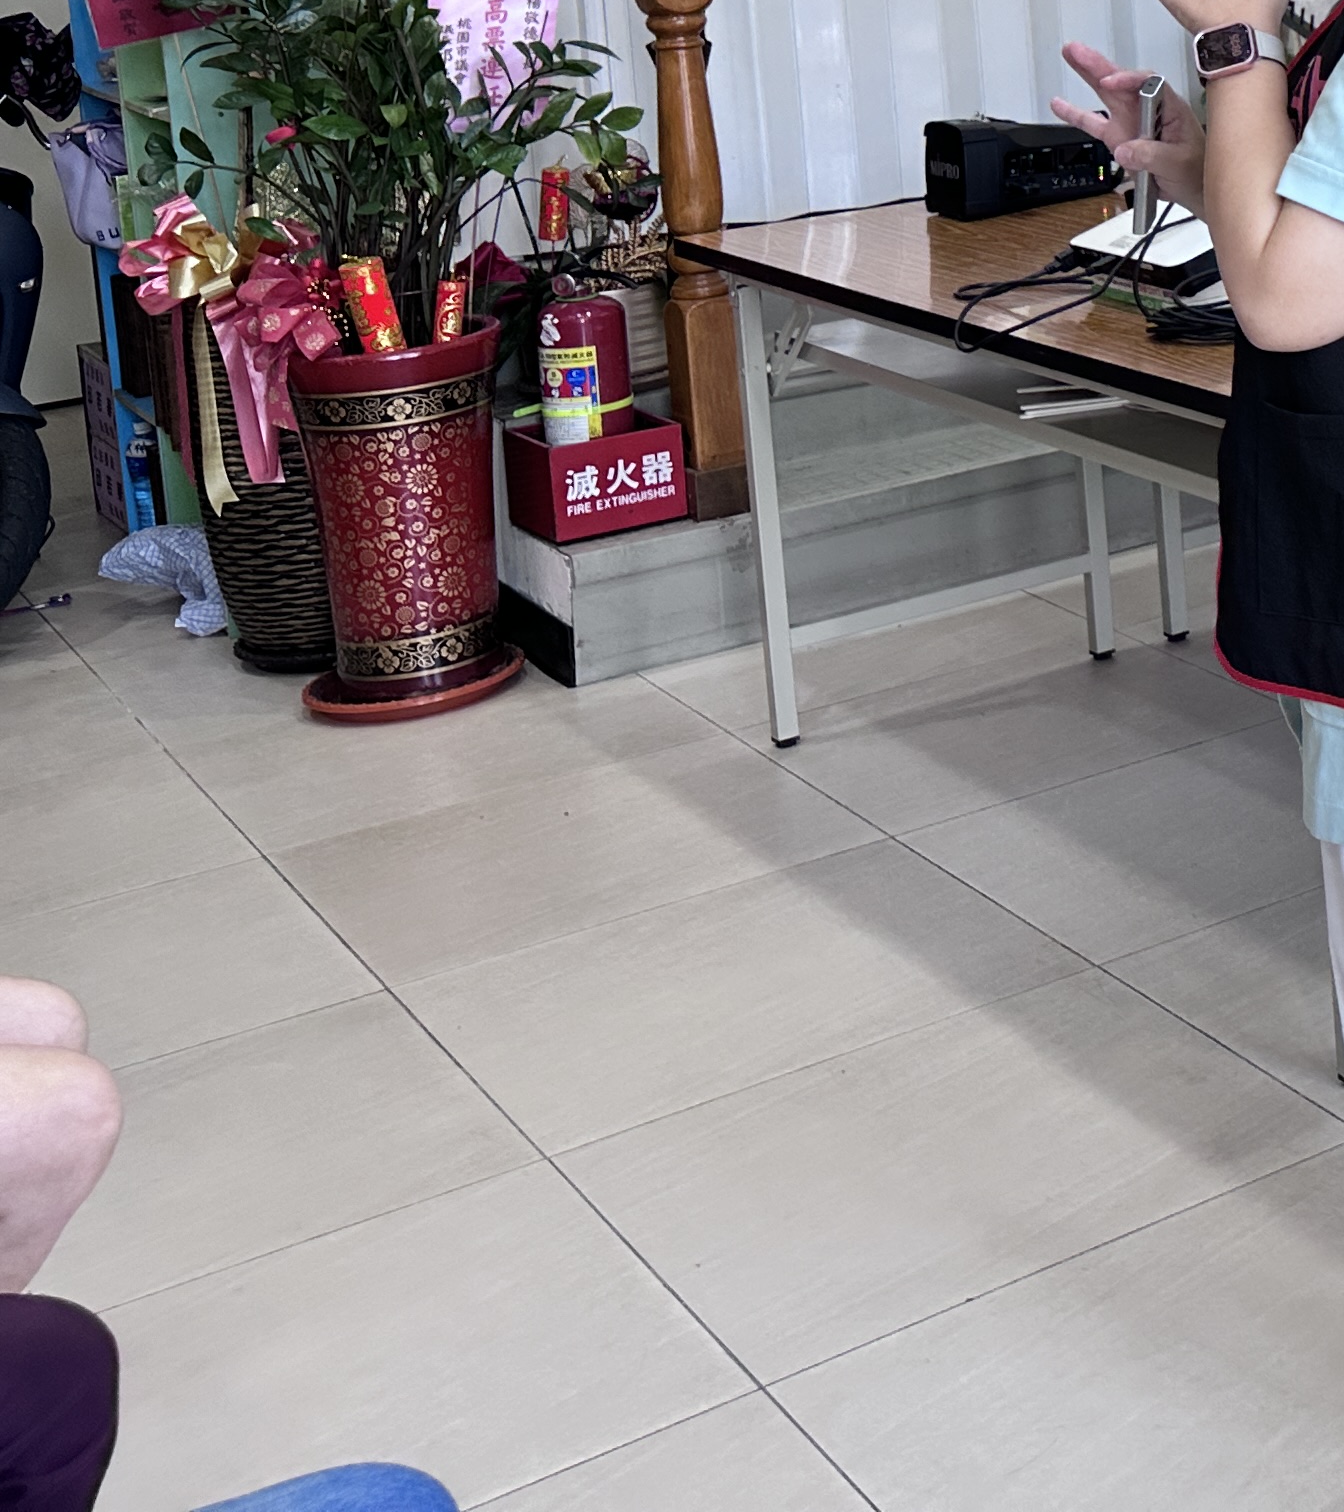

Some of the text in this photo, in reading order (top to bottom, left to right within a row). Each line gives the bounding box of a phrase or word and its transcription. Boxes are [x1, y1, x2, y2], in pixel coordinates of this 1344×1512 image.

[565, 451, 674, 502] 滅火器
[566, 484, 676, 517] FIRE EXTINGUISHER
